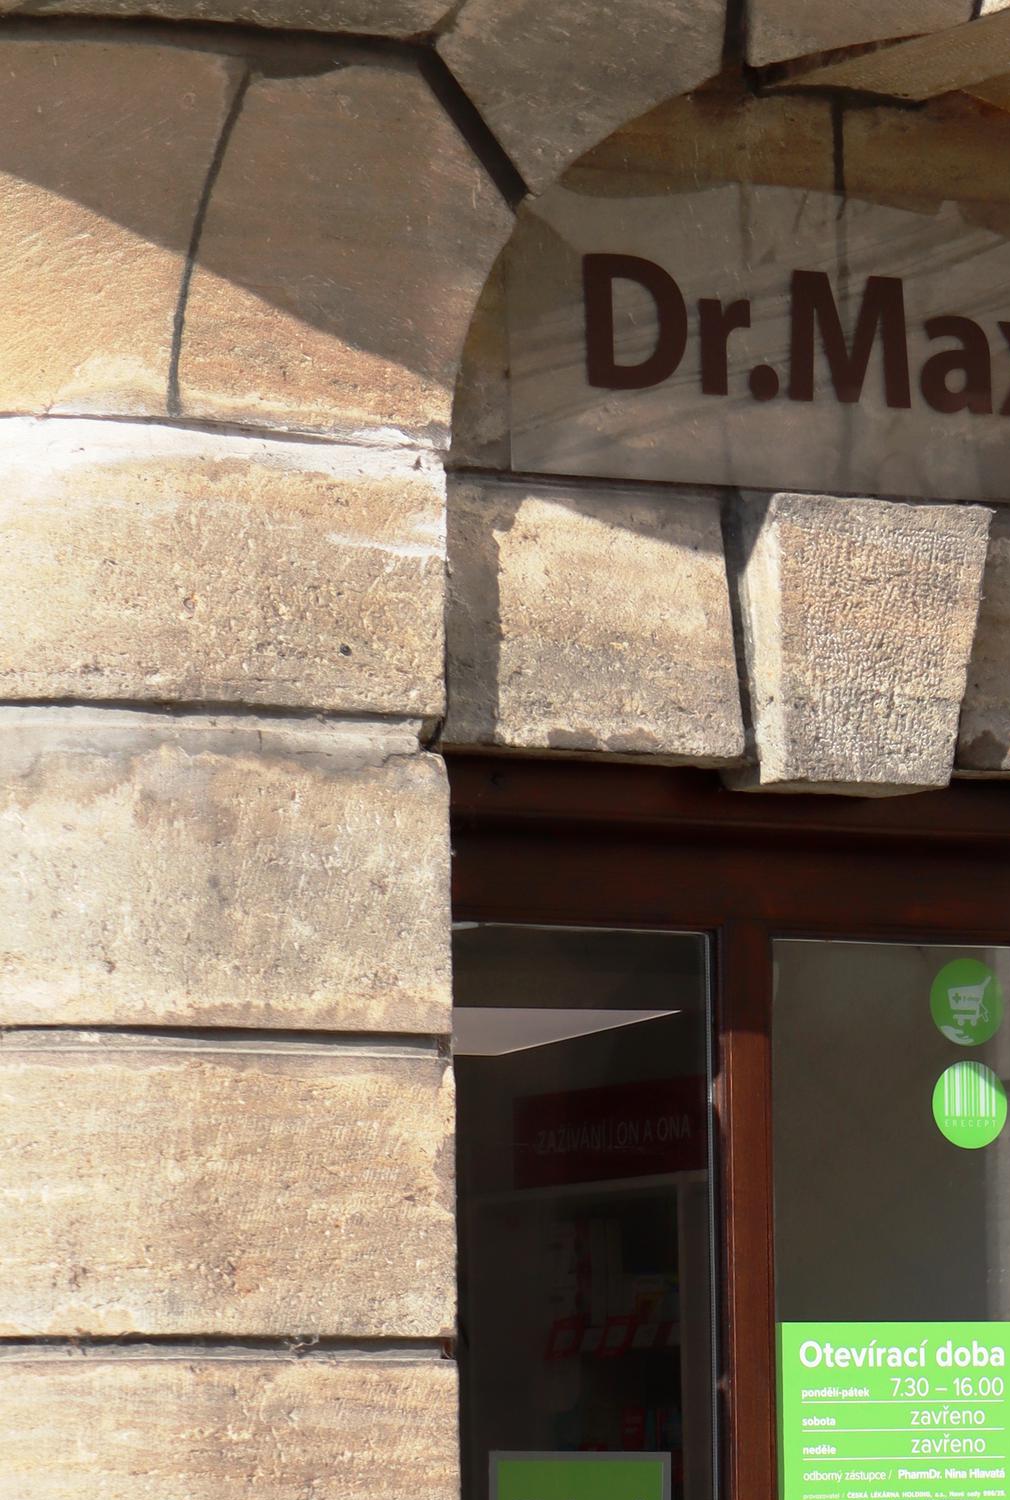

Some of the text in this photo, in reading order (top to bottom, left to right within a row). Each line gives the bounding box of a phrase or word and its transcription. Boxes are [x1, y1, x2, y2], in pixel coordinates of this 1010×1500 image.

[800, 1340, 1005, 1368] Otevírací doba
[801, 1386, 870, 1400] pondělí-pátek
[889, 1377, 929, 1397] 7.30
[952, 1377, 1004, 1396] 16.00
[802, 1405, 985, 1427] sobota zavřeno
[803, 1433, 986, 1455] neděle zavřeno
[803, 1469, 842, 1483] odborný
[845, 1469, 886, 1482] zástupce
[898, 1468, 942, 1480] PharmDr.
[945, 1468, 967, 1479] Nina
[969, 1467, 1005, 1479] Hlavatá
